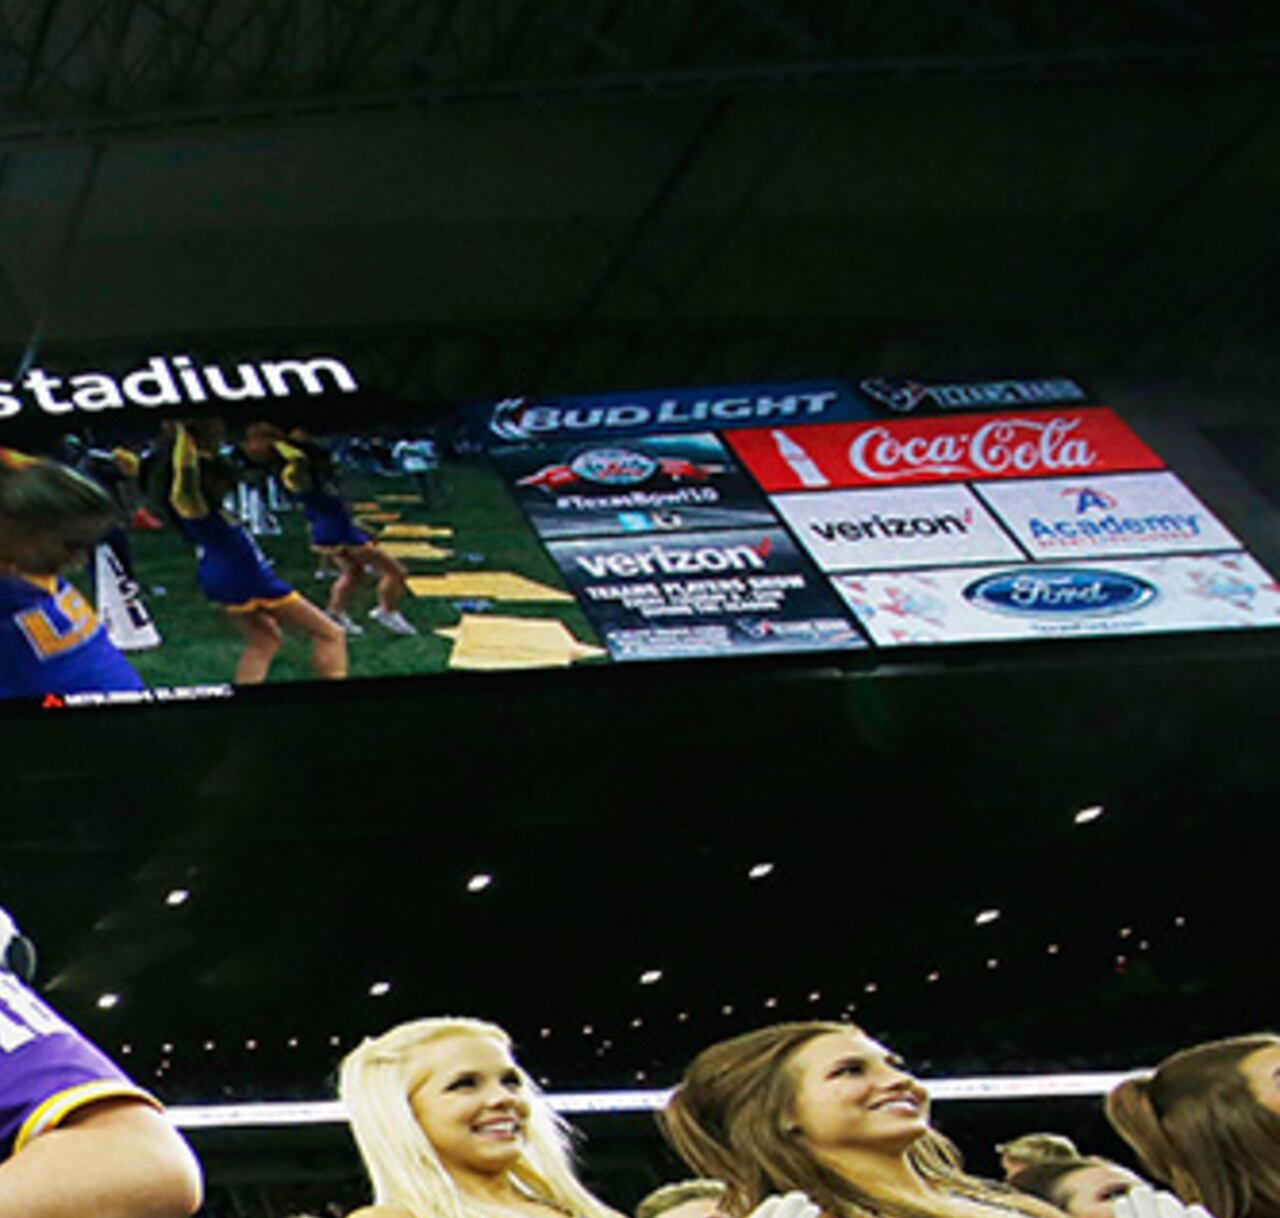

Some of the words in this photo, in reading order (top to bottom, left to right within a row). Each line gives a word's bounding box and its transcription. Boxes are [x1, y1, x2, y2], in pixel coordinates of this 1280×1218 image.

[520, 404, 653, 432] BUD
[657, 391, 839, 424] LIGHT
[849, 418, 1096, 479] Coca-Cola
[811, 511, 968, 543] verizon
[1029, 514, 1201, 539] Academy
[576, 544, 765, 578] verizon
[1009, 576, 1109, 606] Ford
